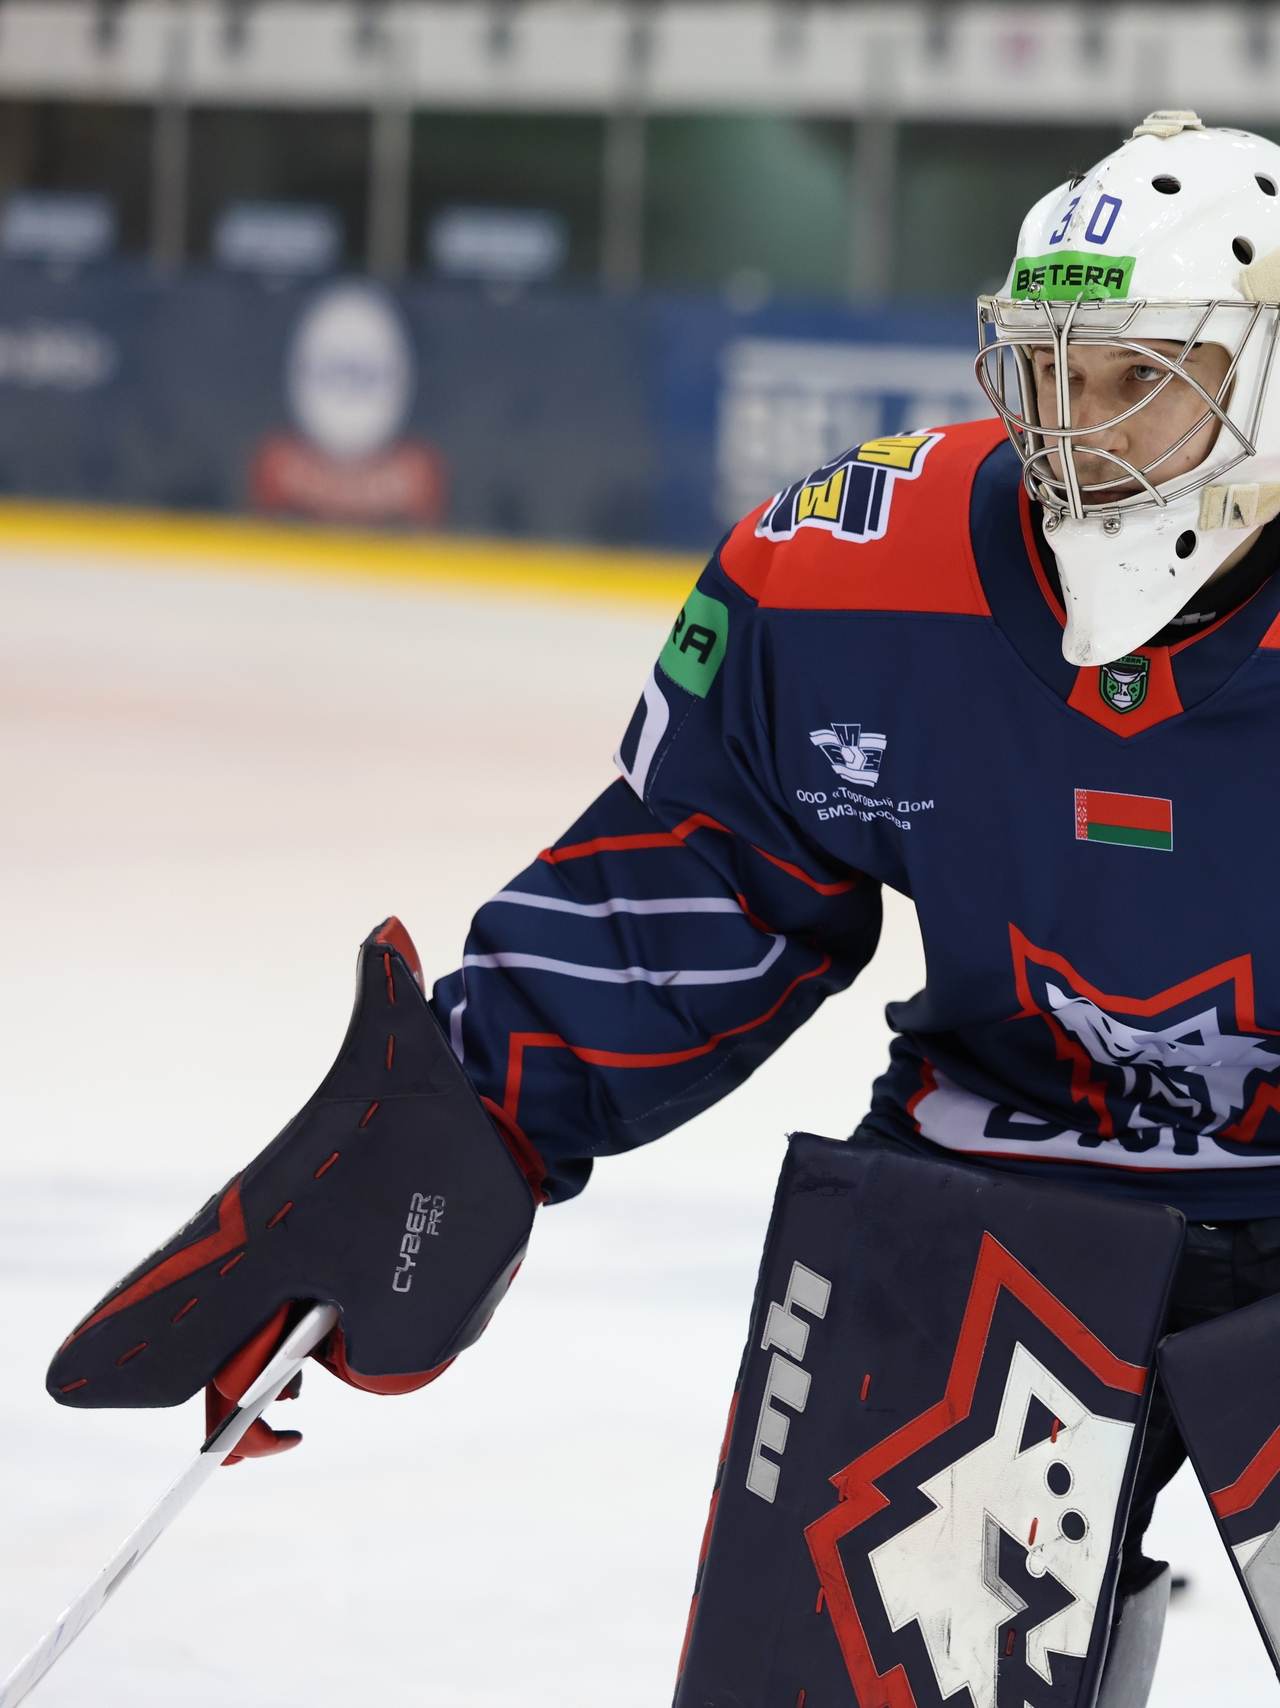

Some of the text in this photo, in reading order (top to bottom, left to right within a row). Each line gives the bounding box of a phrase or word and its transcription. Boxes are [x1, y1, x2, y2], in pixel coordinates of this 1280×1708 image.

[1016, 264, 1124, 292] BET.ERA
[796, 789, 828, 804] ООО
[896, 800, 935, 813] Дом
[426, 1195, 446, 1236] PRO
[392, 1192, 432, 1293] CYBER
